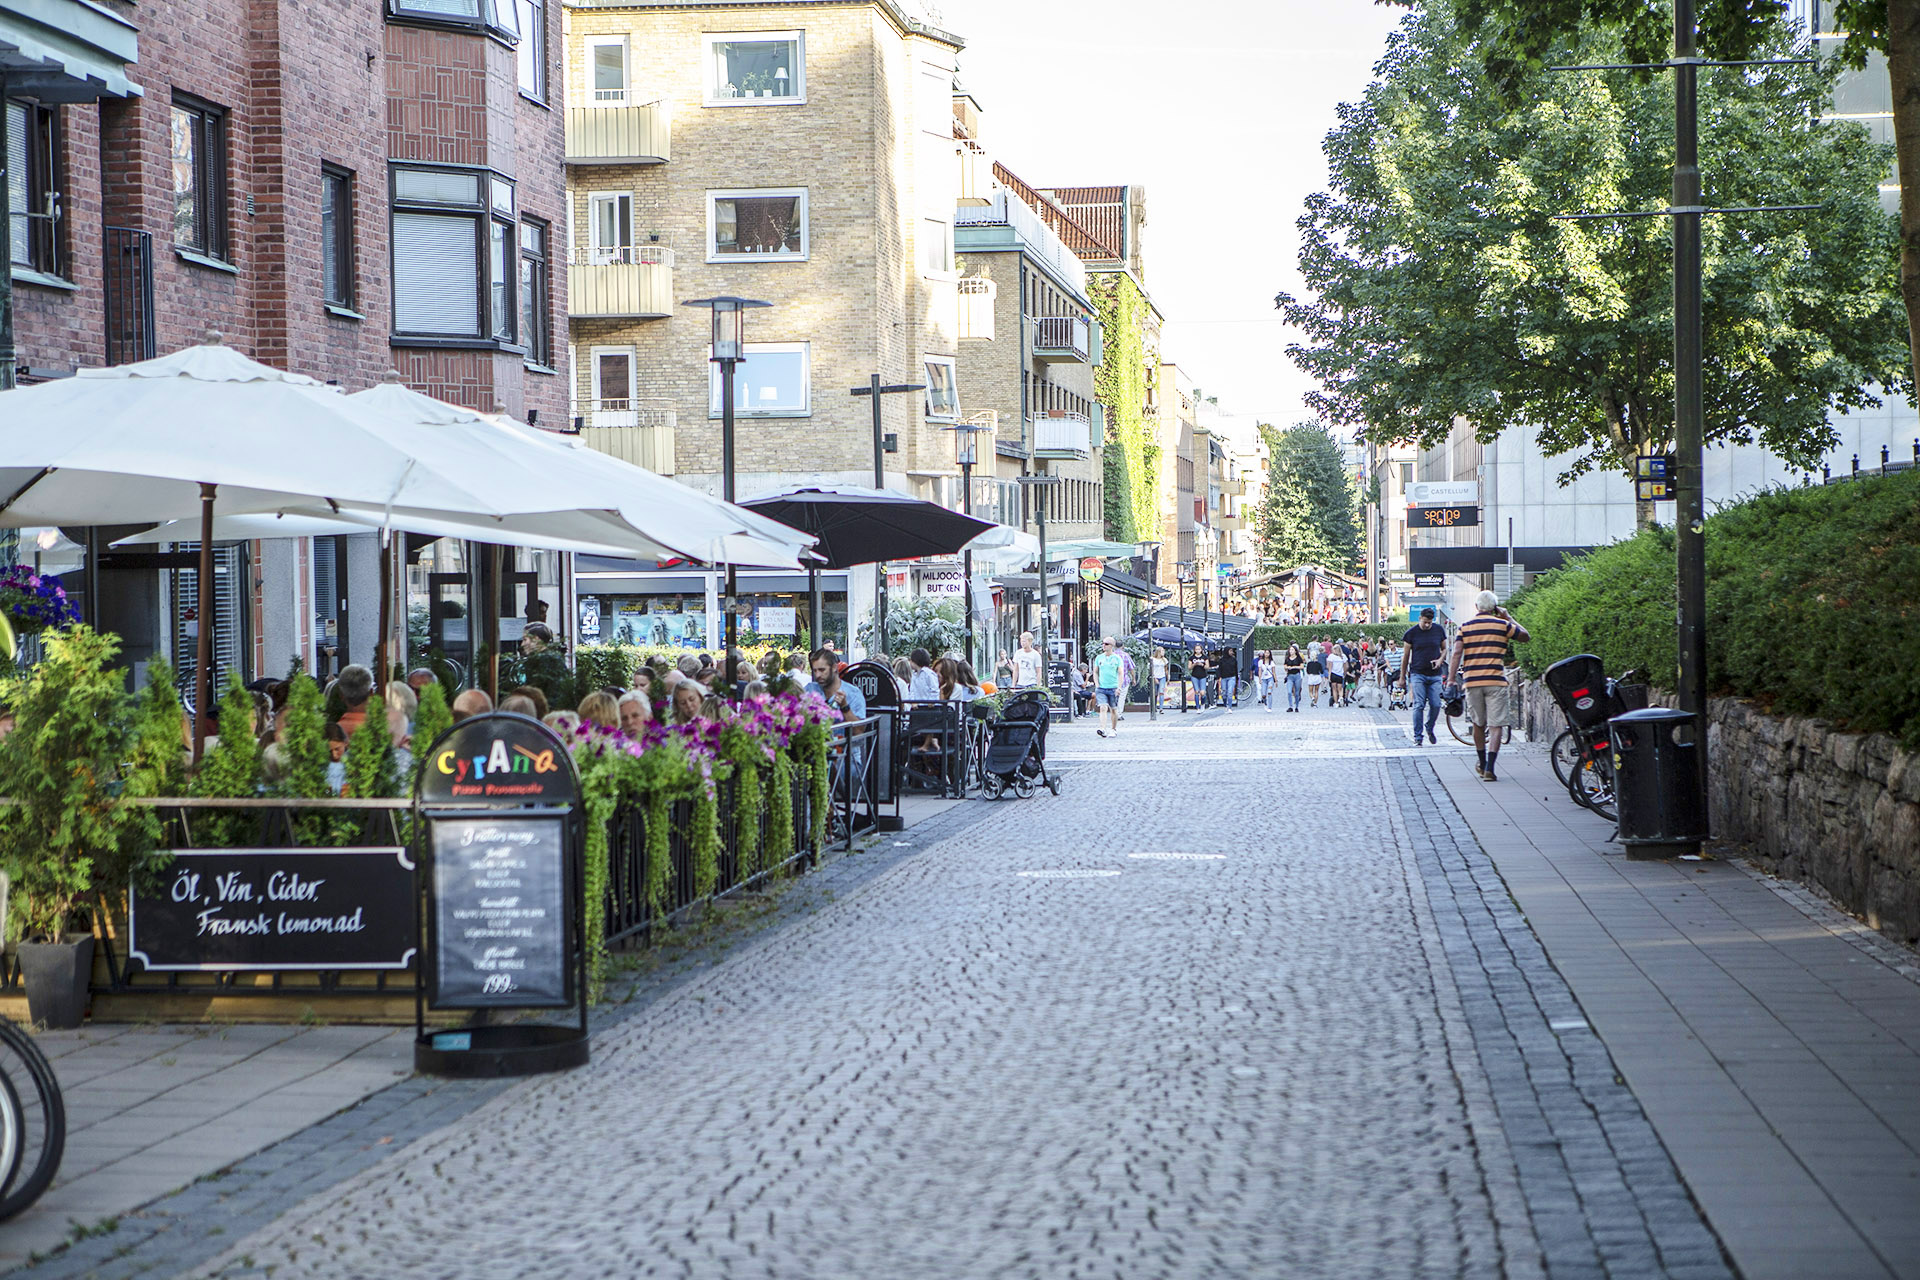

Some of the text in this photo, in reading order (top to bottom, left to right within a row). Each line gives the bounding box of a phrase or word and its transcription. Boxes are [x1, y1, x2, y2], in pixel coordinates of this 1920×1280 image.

[1424, 509, 1461, 521] spring
[927, 584, 961, 593] BUTKEN
[583, 616, 599, 629] 50
[196, 906, 273, 937] Fransk
